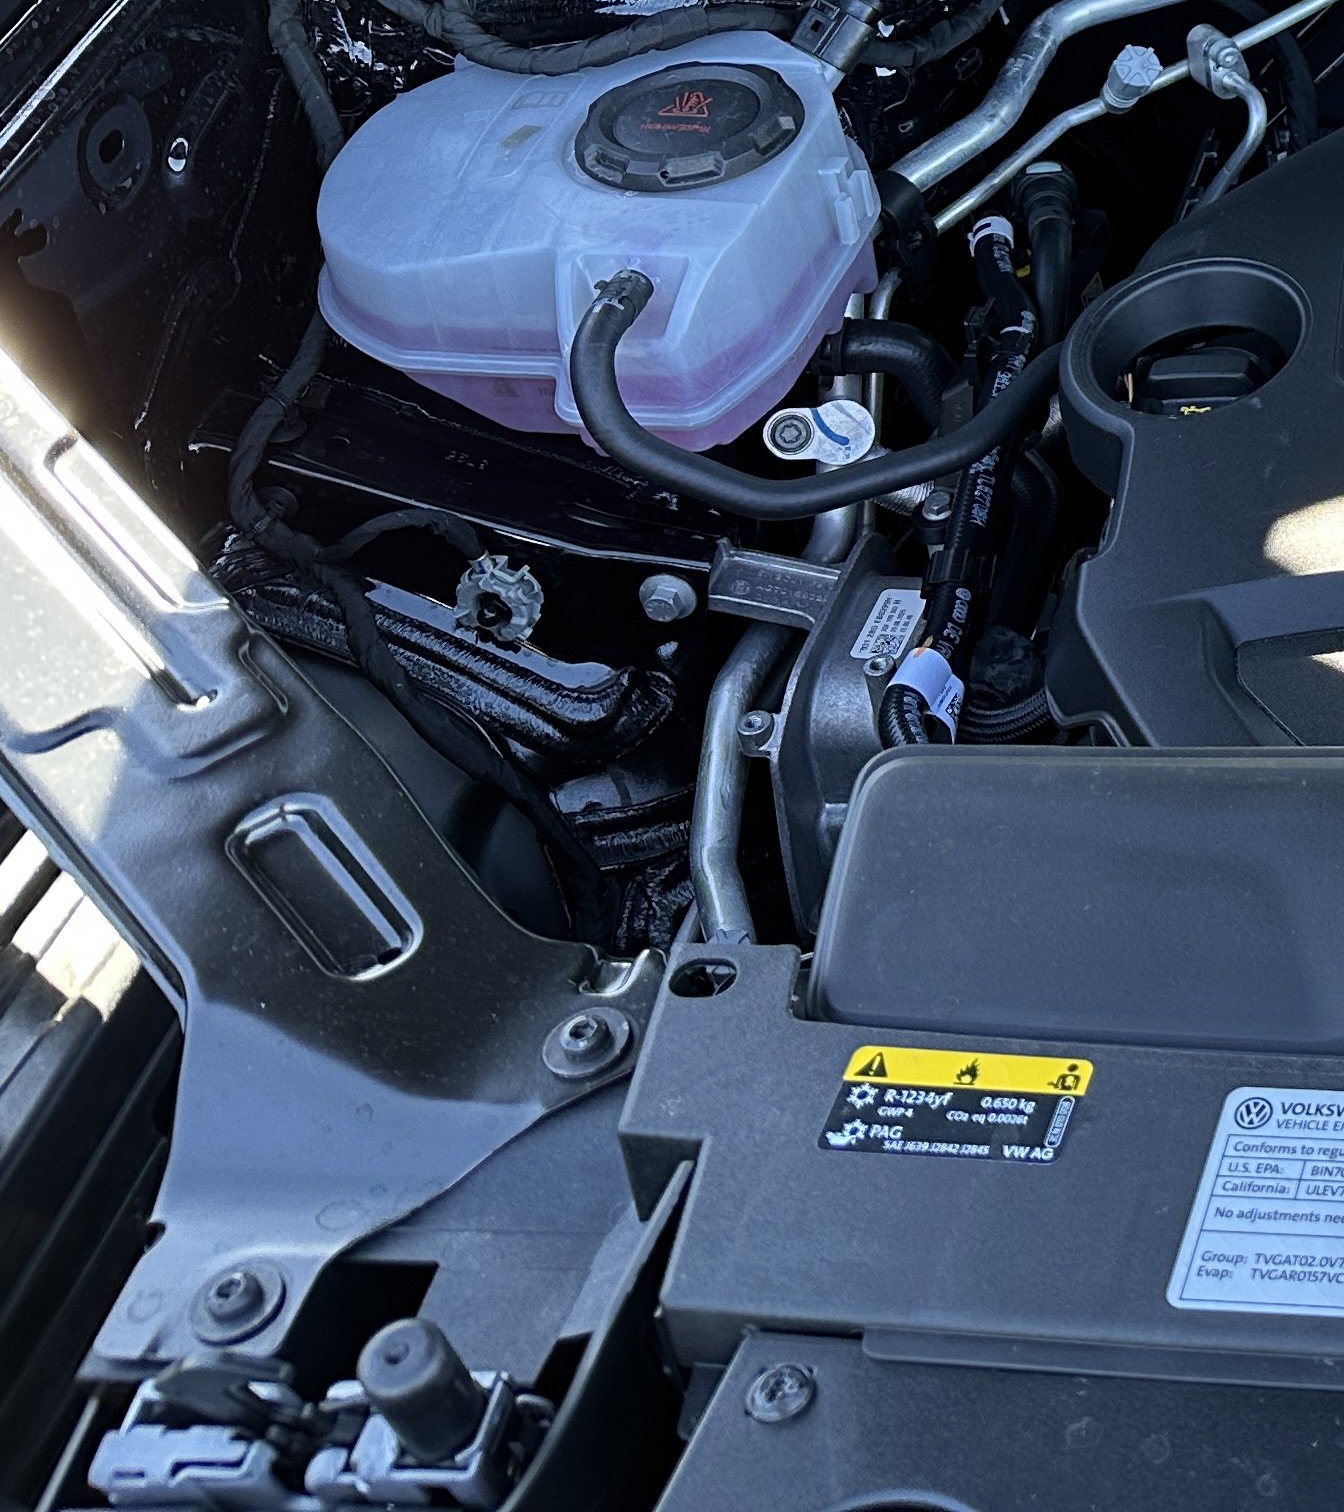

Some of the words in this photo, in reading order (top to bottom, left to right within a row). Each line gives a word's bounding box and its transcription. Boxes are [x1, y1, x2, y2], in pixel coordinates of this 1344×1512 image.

[884, 1089, 954, 1109] R-1234yf
[1019, 1098, 1036, 1114] kg
[869, 1124, 904, 1139] PAG
[1276, 1119, 1329, 1131] VEHICLE
[883, 1140, 904, 1150] SAE
[1002, 1144, 1030, 1158] VW
[1030, 1147, 1054, 1160] AG
[1233, 1141, 1297, 1155] Conforms
[1300, 1144, 1314, 1155] to
[1227, 1162, 1249, 1173] U.S.
[1256, 1163, 1284, 1174] EPA:
[1222, 1180, 1290, 1195] California:
[1214, 1207, 1233, 1218] No
[1236, 1208, 1321, 1223] adjustments
[1201, 1251, 1248, 1265] Group:
[1197, 1265, 1233, 1280] Evap:
